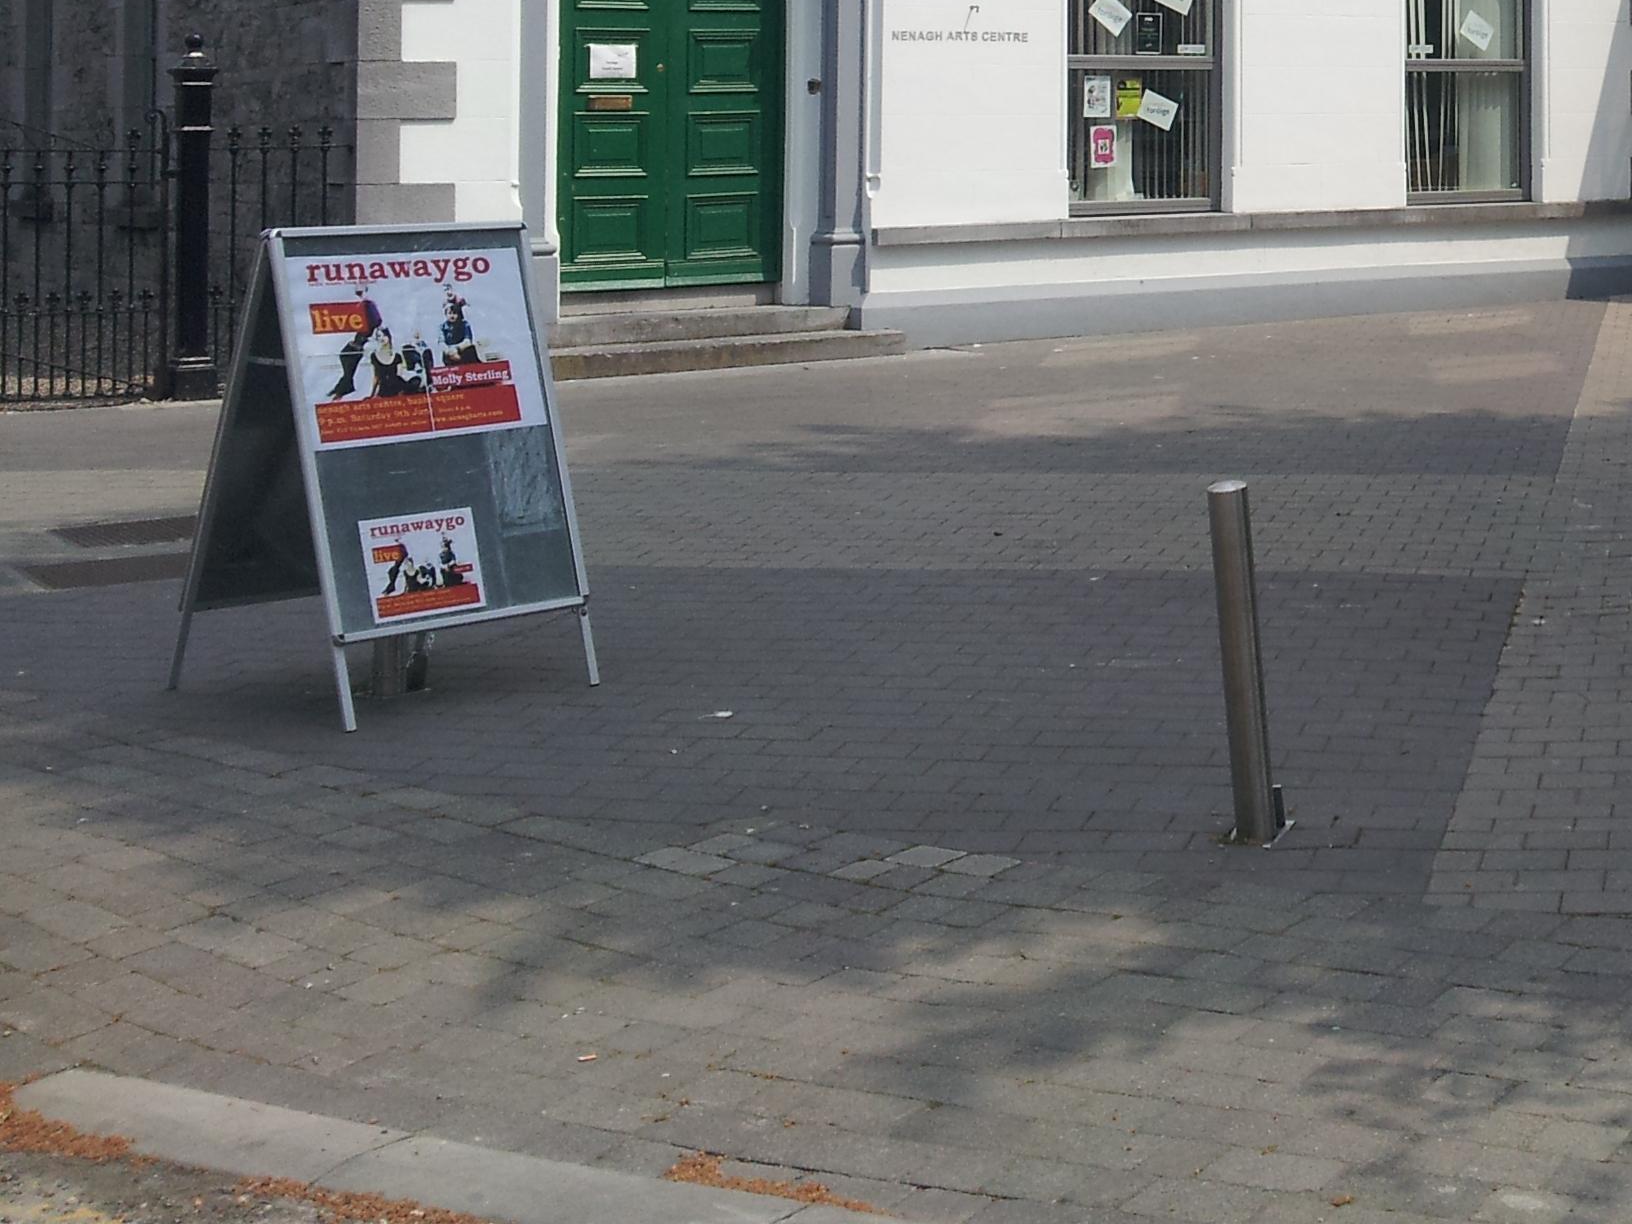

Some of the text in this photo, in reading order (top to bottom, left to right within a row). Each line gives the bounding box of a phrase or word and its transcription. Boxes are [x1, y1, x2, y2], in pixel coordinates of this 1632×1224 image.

[891, 30, 1029, 43] NENAGH ARTS CENTRE
[306, 256, 491, 283] runawaygo
[311, 309, 364, 333] live
[431, 373, 463, 385] Molly
[465, 370, 509, 382] Sterling
[370, 516, 465, 537] runawaygo
[373, 550, 401, 563] live
